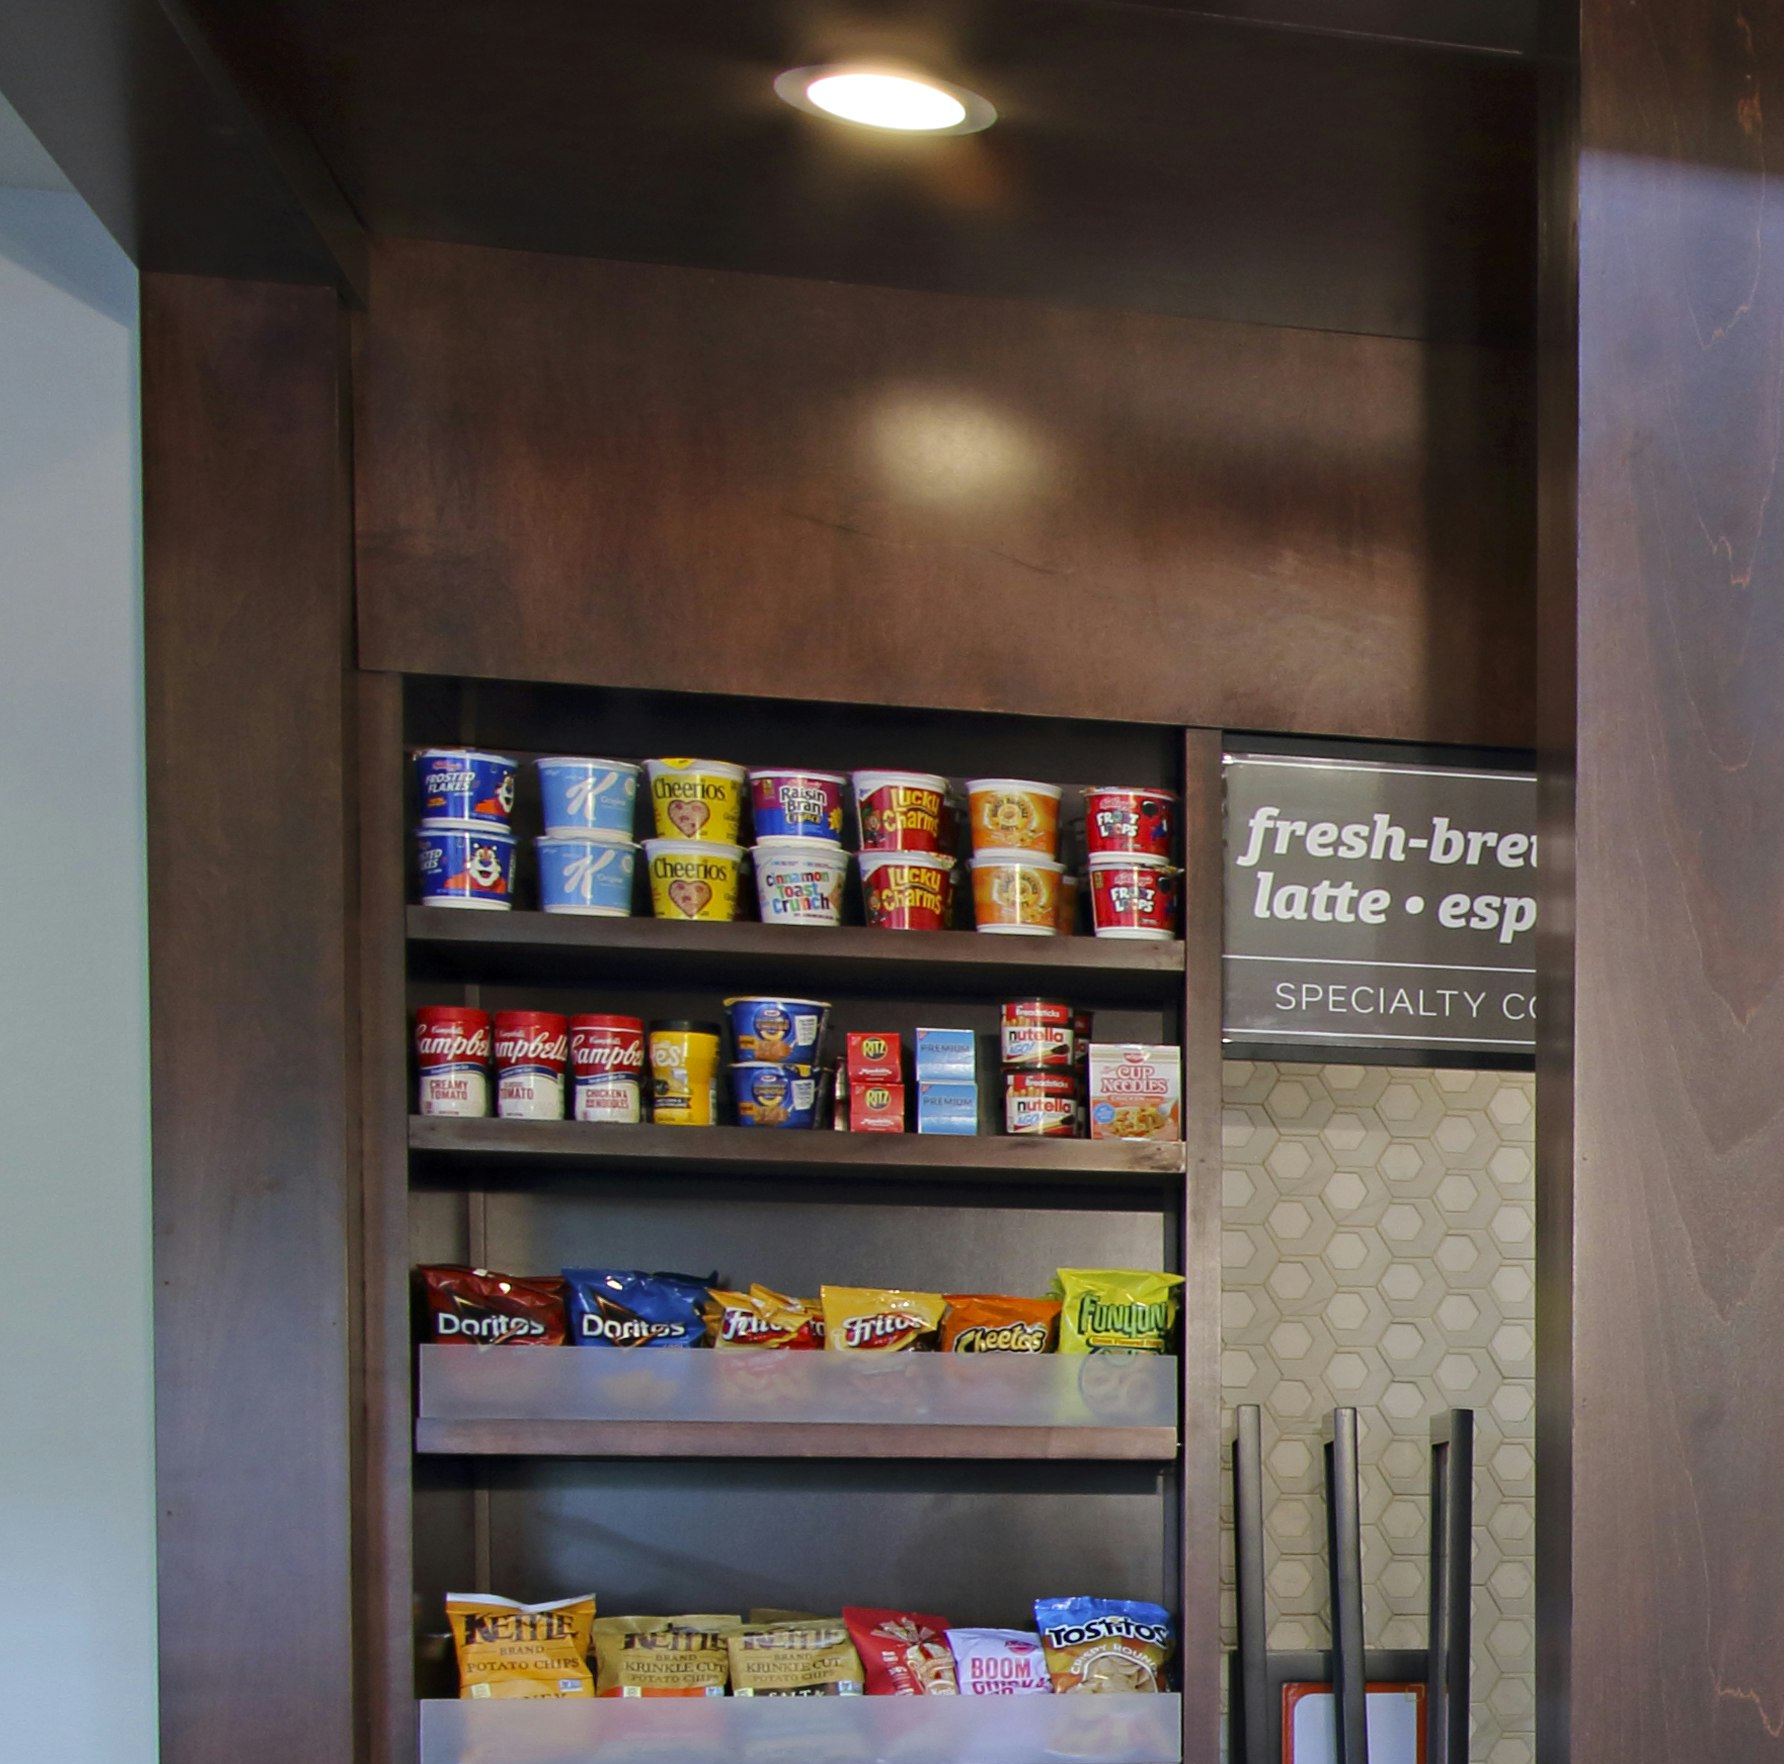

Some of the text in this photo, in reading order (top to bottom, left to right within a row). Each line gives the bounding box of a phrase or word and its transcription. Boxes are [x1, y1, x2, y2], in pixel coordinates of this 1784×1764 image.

[424, 771, 476, 785] FROSTED
[427, 781, 471, 793] FLAKES
[654, 778, 726, 801] Cheerios
[781, 786, 826, 802] Raisin
[785, 801, 823, 815] Bran
[890, 787, 940, 813] Lucky
[883, 808, 940, 834] Charms
[654, 858, 727, 880] Cheerios
[890, 866, 941, 893] Lucky
[772, 892, 830, 913] Crunch
[881, 887, 943, 915] Charms
[1254, 873, 1388, 923] latte
[1275, 981, 1486, 1020] SPECIALTY
[1009, 1030, 1064, 1044] nutella
[861, 1038, 888, 1054] RITZ
[920, 1043, 971, 1053] PREMIUM
[1115, 1065, 1154, 1080] CUP
[430, 1079, 468, 1090] CREAMY
[1101, 1078, 1169, 1094] NOODLES
[430, 1090, 468, 1101] TOMATO
[866, 1090, 891, 1106] RITZ
[922, 1096, 973, 1106] PREMIUM
[1017, 1099, 1072, 1113] nutella
[438, 1312, 546, 1338] Doritos
[581, 1313, 686, 1338] Doritos
[954, 1322, 1048, 1352] Cheetos
[464, 1611, 578, 1647] KETTLE
[499, 1646, 545, 1656] BRAND
[655, 1653, 698, 1662] BRAND
[773, 1653, 815, 1662] BRAND
[467, 1657, 580, 1673] POTATO CHIPS
[624, 1661, 726, 1674] KRINKLE CUT
[746, 1659, 842, 1673] KRINKLE CUT
[971, 1657, 1032, 1679] BOOM
